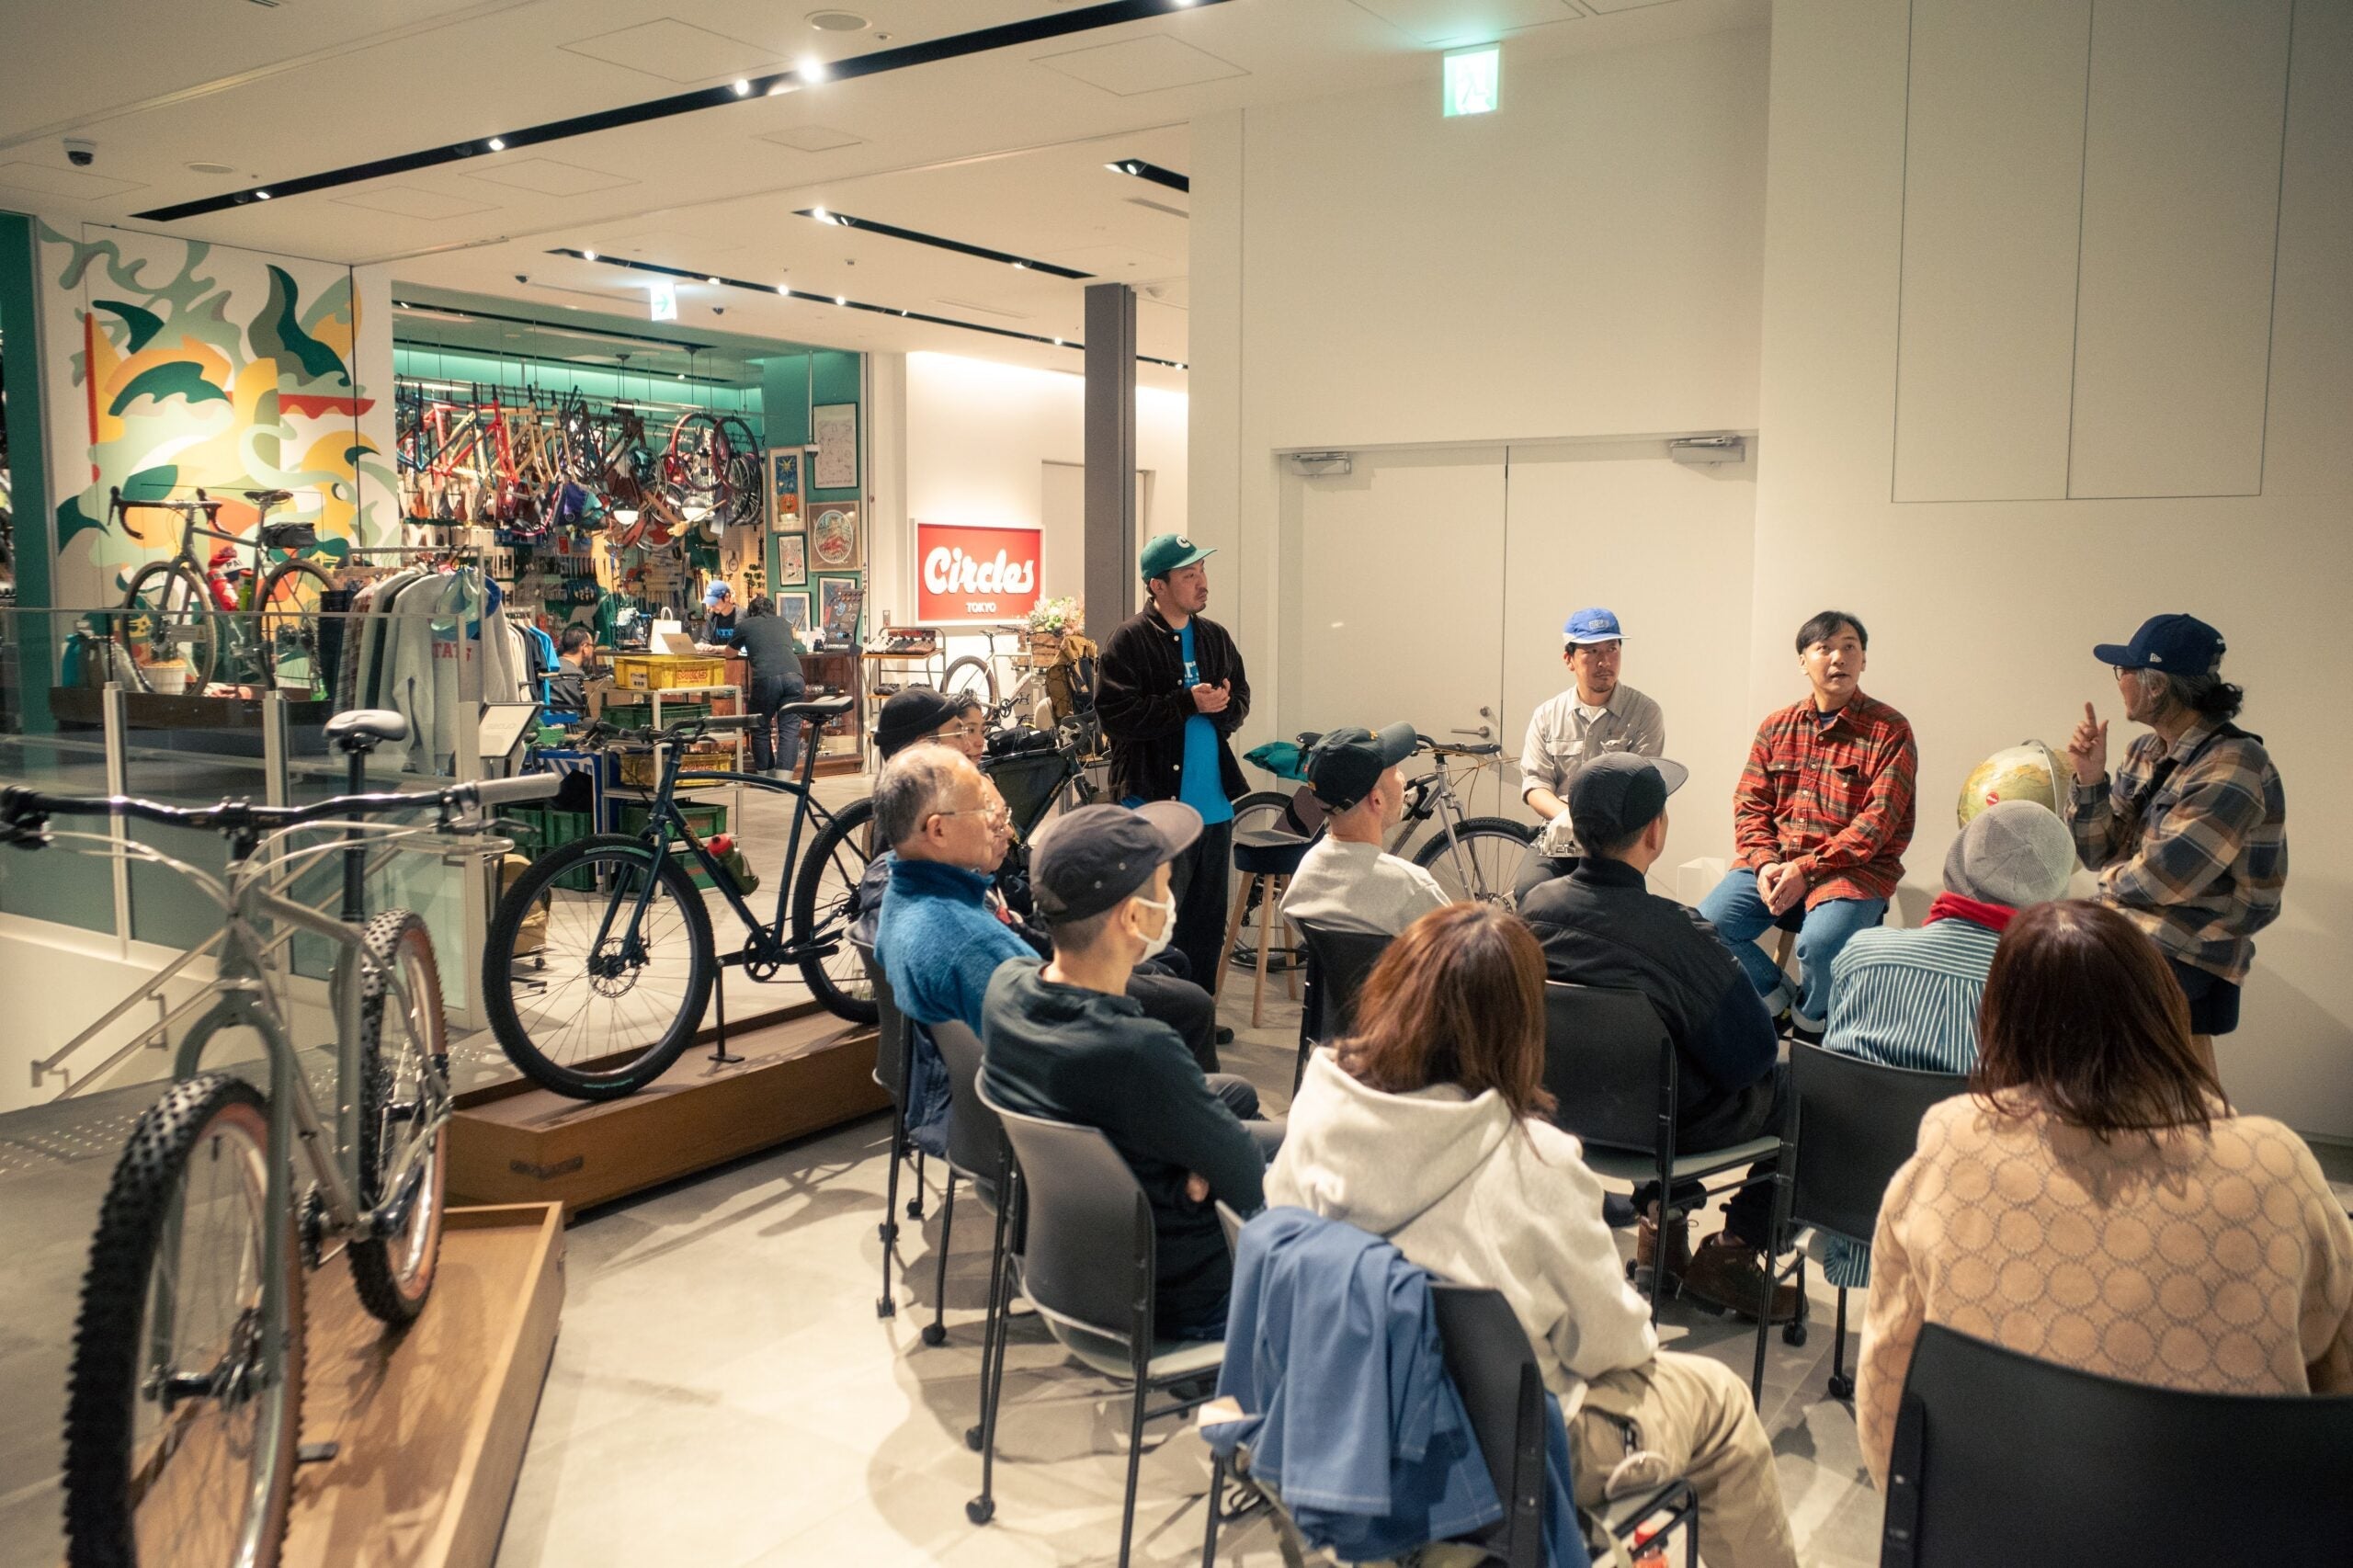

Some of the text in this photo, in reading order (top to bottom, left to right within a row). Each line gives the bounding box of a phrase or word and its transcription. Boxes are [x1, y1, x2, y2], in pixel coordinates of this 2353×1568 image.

[924, 546, 1034, 595] Circles
[966, 602, 997, 613] TOKYO
[676, 668, 708, 680] MKS
